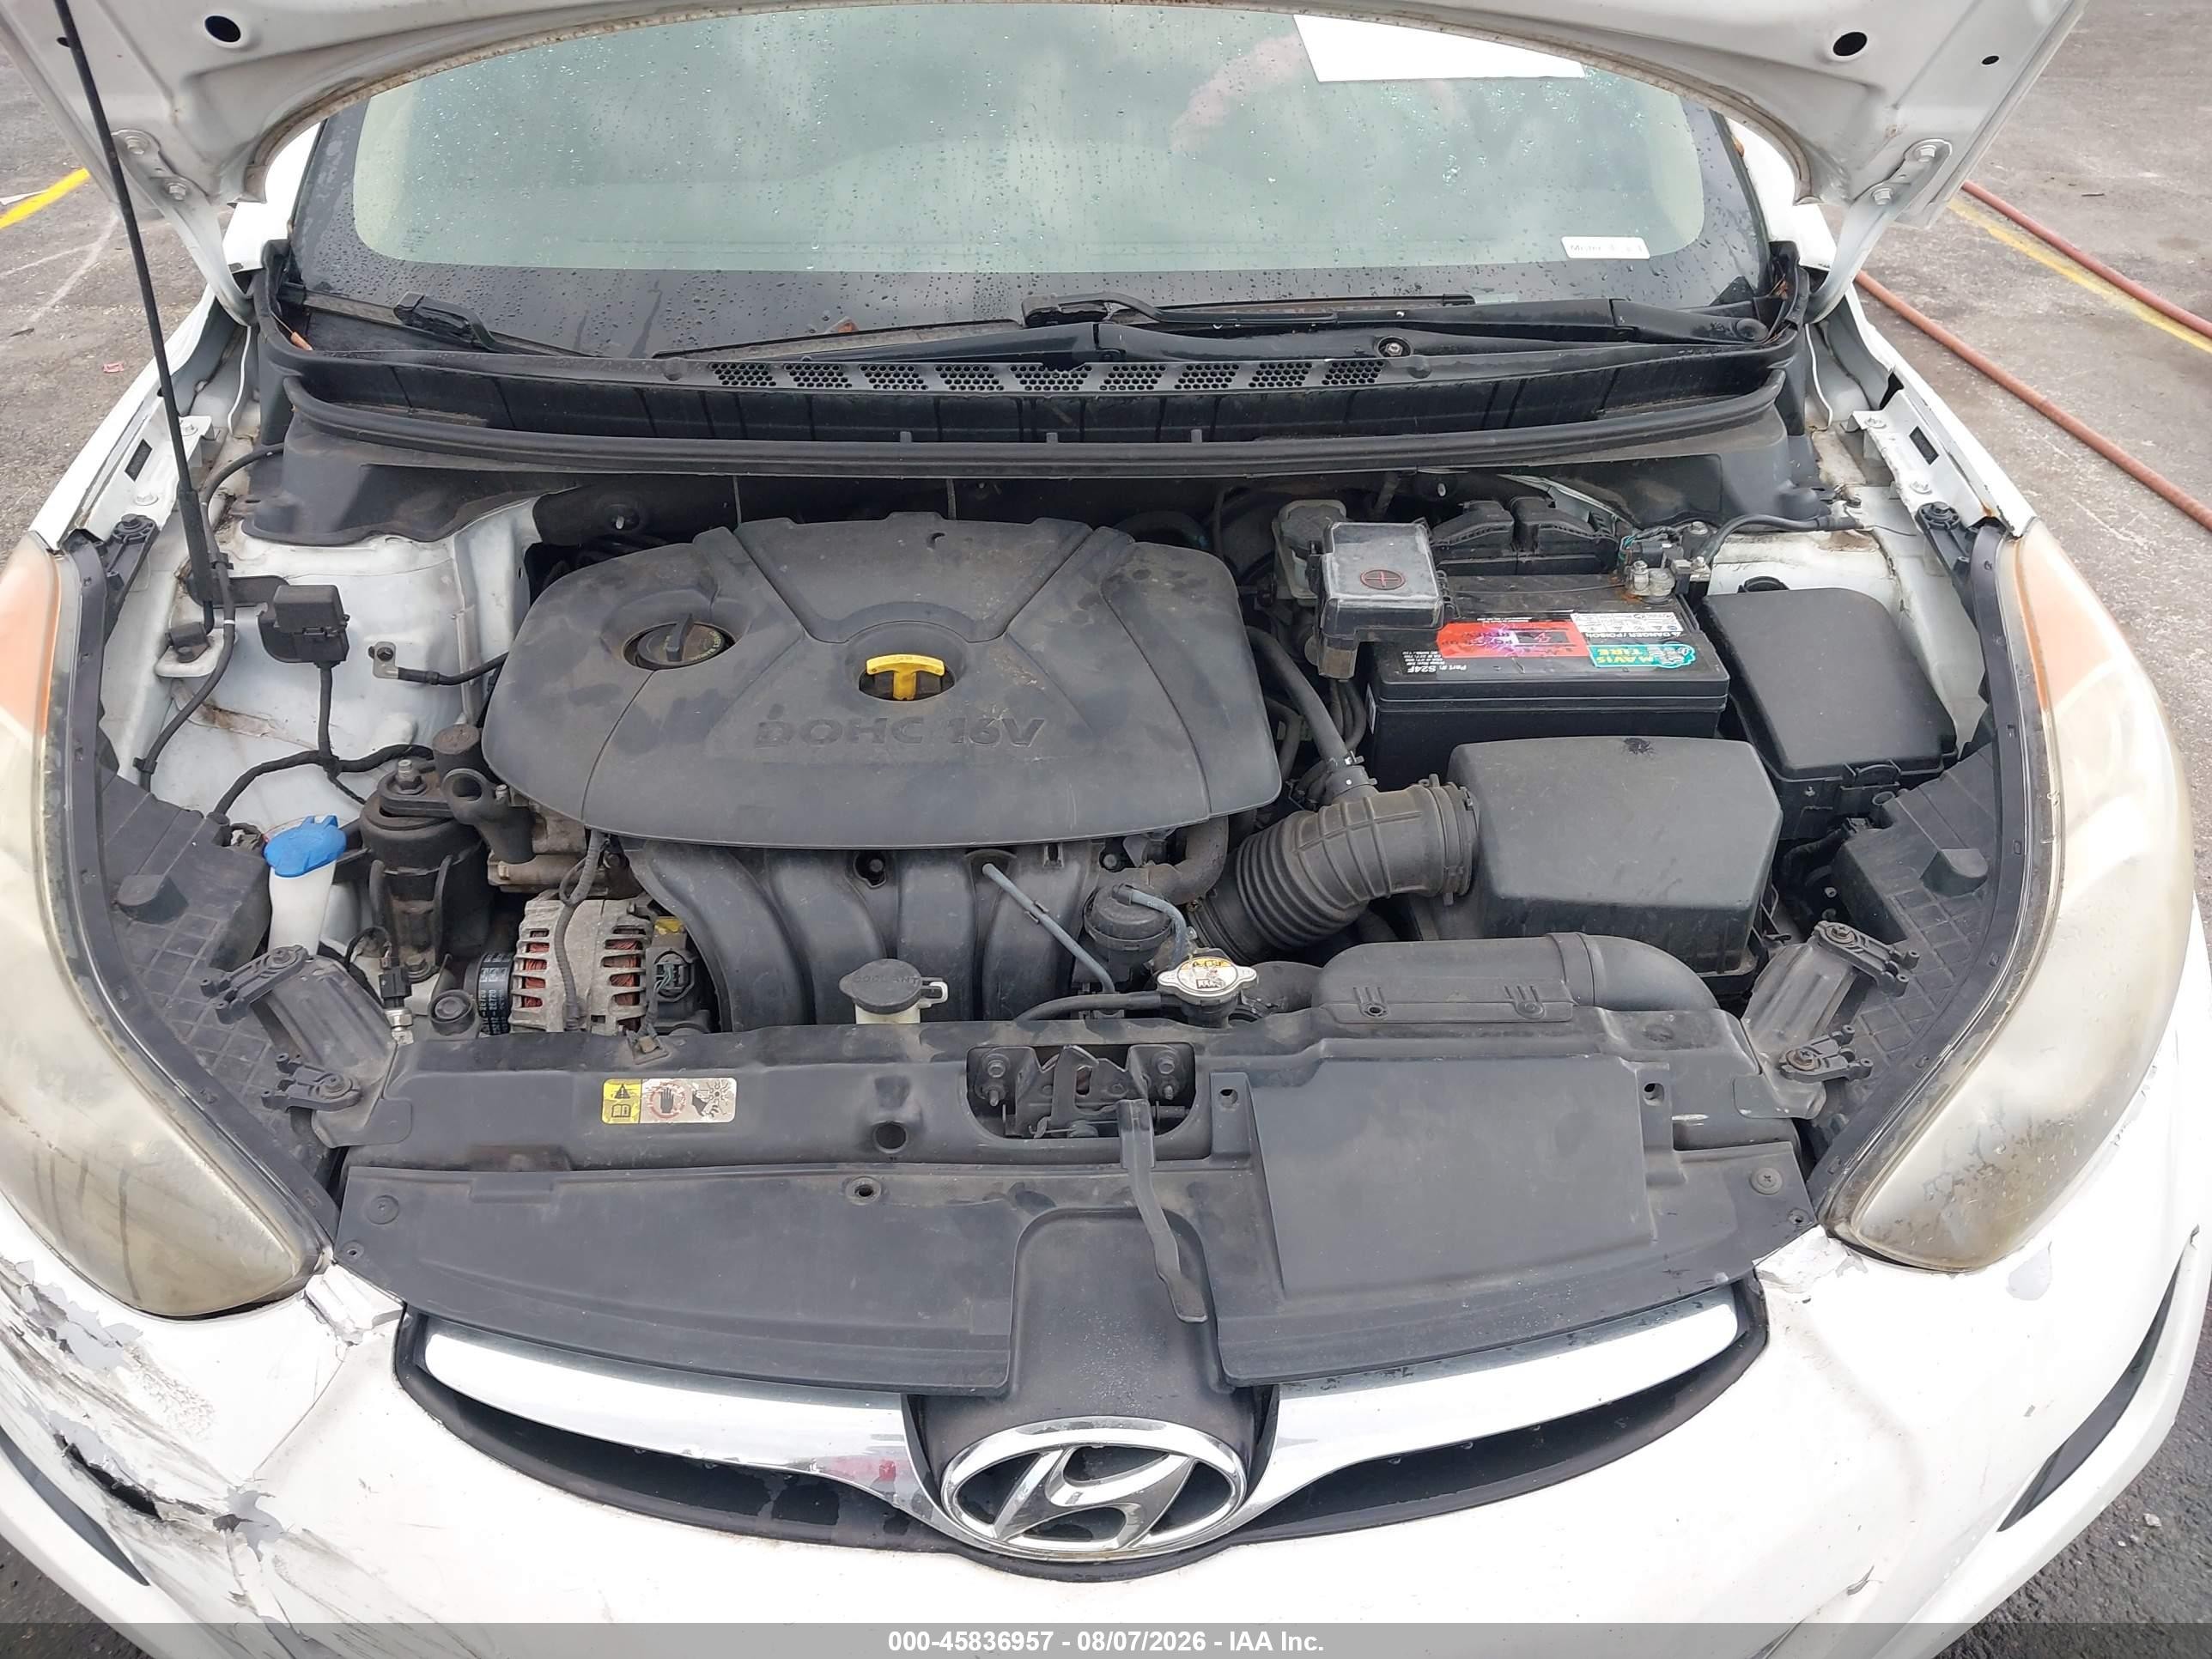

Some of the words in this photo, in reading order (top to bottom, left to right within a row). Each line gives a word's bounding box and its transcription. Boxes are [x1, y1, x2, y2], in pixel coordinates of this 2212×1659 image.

[1595, 655, 1655, 664] MAVIS
[755, 717, 925, 748] DOHC
[948, 715, 1045, 748] 16V
[853, 975, 920, 985] COOLANT
